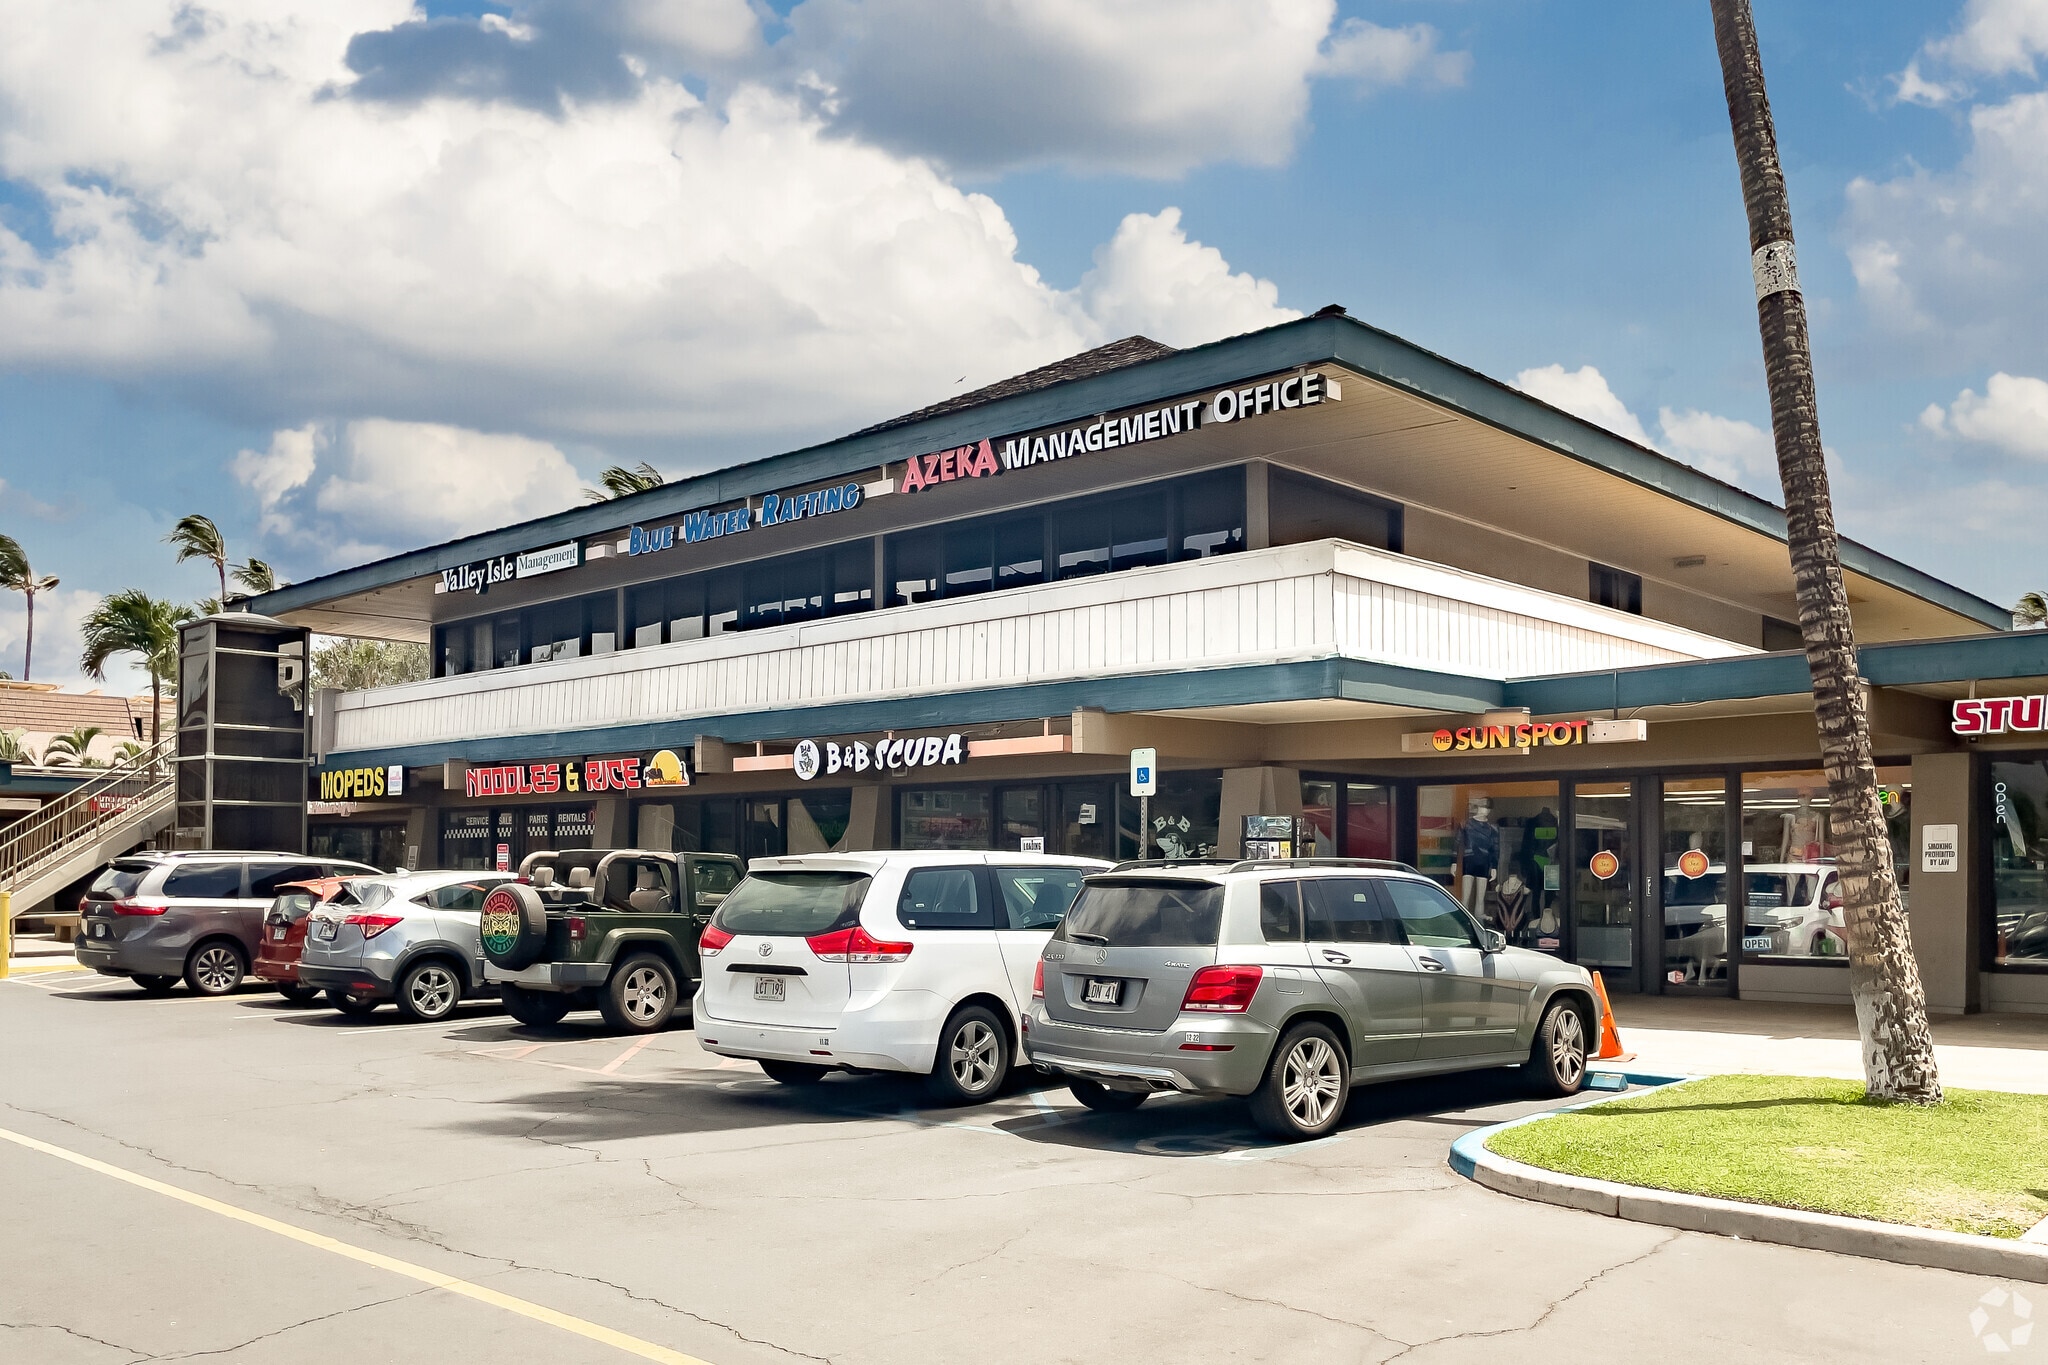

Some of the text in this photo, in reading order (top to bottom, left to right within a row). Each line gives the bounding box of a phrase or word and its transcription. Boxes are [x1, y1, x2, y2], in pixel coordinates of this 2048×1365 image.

[901, 373, 1322, 493] AZEKA MANAGEMENT OFFICE
[629, 483, 860, 556] BLUE WATER RAFTING
[441, 547, 576, 595] Valley Isle Management
[1952, 695, 2048, 735] STU
[1435, 720, 1588, 751] THE SUN SPOT
[826, 733, 963, 774] B&B SCUBA
[321, 766, 384, 799] MOPEDS
[466, 758, 642, 797] NOODLES & RICE
[1878, 791, 1900, 805] en
[466, 816, 489, 826] SERVICE
[529, 814, 548, 825] PARTS
[558, 812, 587, 823] RENTALS
[1153, 815, 1191, 833] B & B
[1023, 842, 1042, 851] LOADING
[1930, 858, 1950, 866] BY LAW
[1744, 938, 1770, 949] OPEN
[755, 982, 784, 996] LCT 193
